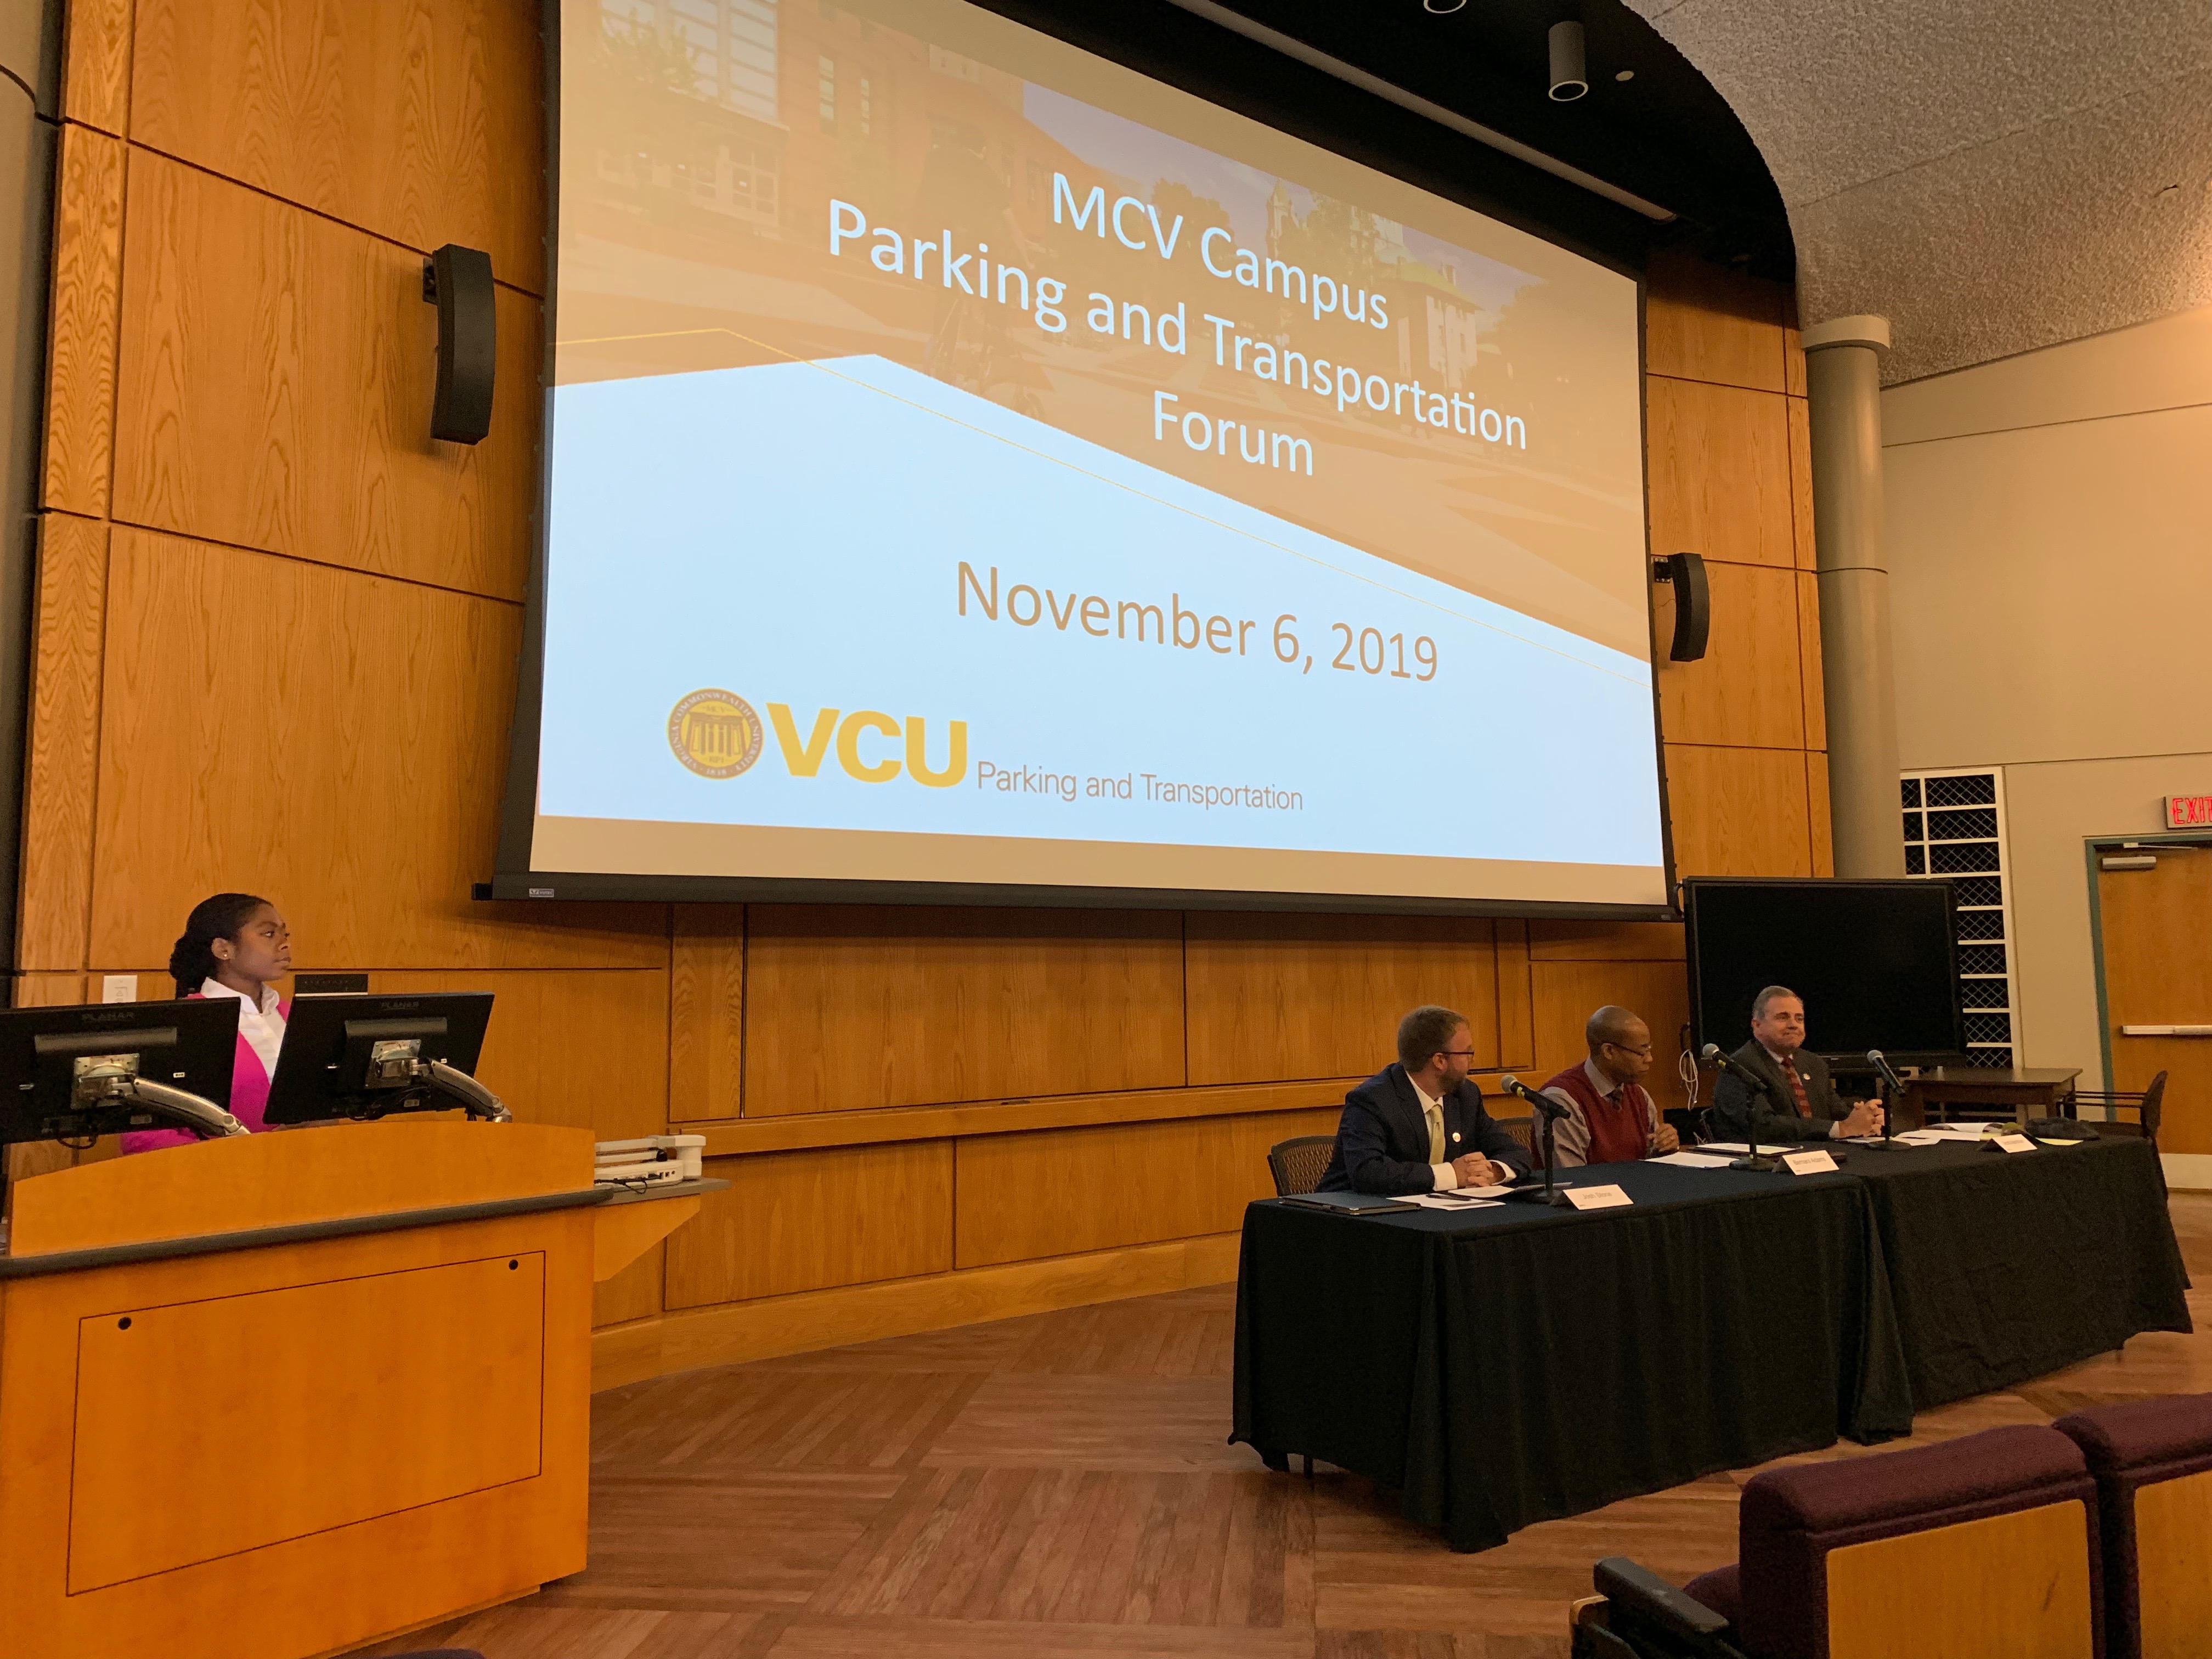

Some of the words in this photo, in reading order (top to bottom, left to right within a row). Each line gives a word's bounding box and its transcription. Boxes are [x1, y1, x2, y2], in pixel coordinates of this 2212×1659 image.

[1052, 172, 1184, 259] MCV
[1201, 227, 1389, 329] Campus
[830, 199, 1066, 333] Parking
[1087, 293, 1186, 354] and
[1204, 314, 1526, 449] Transportation
[1154, 391, 1313, 476] Forum
[957, 560, 1256, 657] November
[1272, 613, 1313, 675] 6,
[1331, 622, 1438, 682] 2019
[765, 702, 968, 788] VCU
[977, 760, 1076, 802] Parking
[1086, 772, 1133, 799] and
[1140, 774, 1303, 810] Transportation
[2172, 797, 2212, 824] EXIT
